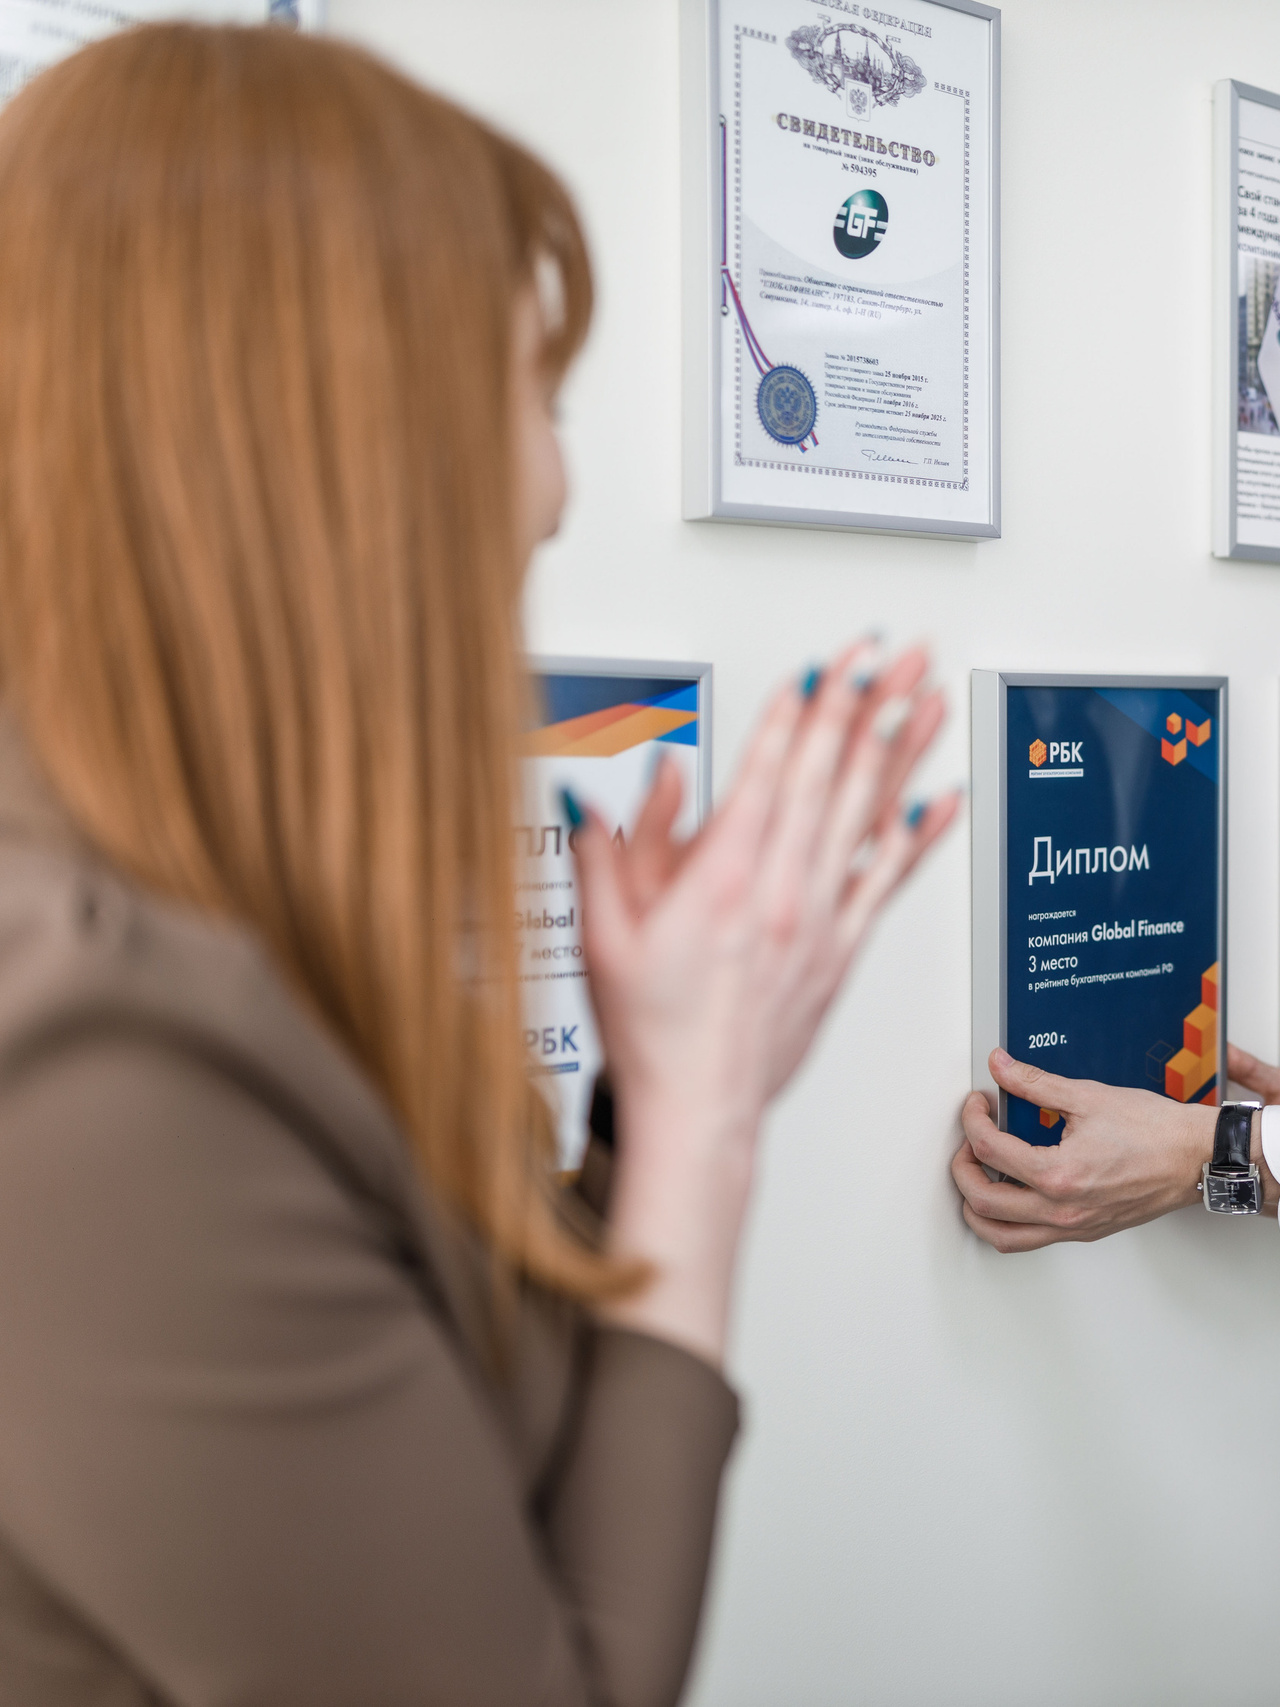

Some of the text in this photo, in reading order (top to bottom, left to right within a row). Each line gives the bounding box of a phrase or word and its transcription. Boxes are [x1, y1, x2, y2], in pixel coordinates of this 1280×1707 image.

[863, 7, 932, 39] ФЕДЕРАЦИЯ
[777, 113, 936, 167] СВИДЕТЕЛЬСТВО
[850, 163, 877, 178] 594395
[1249, 206, 1255, 218] 4
[1050, 741, 1084, 764] РБК
[1028, 910, 1077, 923] награждается
[1028, 920, 1185, 948] компания Global Finance
[1028, 955, 1078, 973] 3 место
[1028, 963, 1174, 993] в рейтинге бухгалтерских компаний РФ
[524, 1024, 580, 1055] РБК
[1028, 1032, 1068, 1049] 2020 г.
